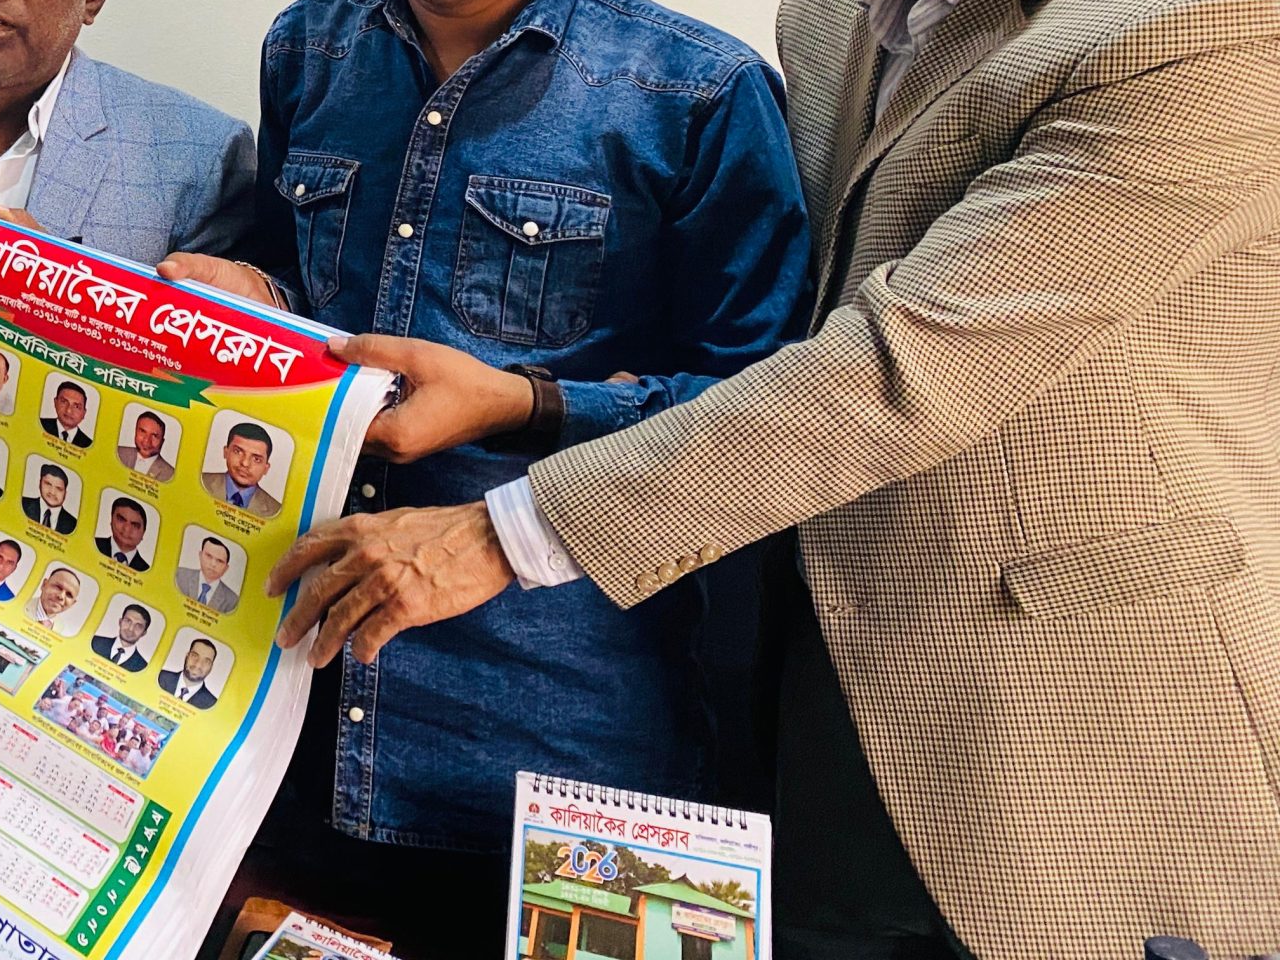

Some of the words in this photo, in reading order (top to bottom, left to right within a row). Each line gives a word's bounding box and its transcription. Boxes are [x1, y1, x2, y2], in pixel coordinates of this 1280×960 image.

[150, 301, 306, 383] প্রেসক্লাব
[93, 360, 159, 399] পরিষদ
[549, 804, 627, 837] কালিয়াকৈর
[632, 823, 690, 851] প্রেসক্লাব
[554, 845, 618, 884] 2026
